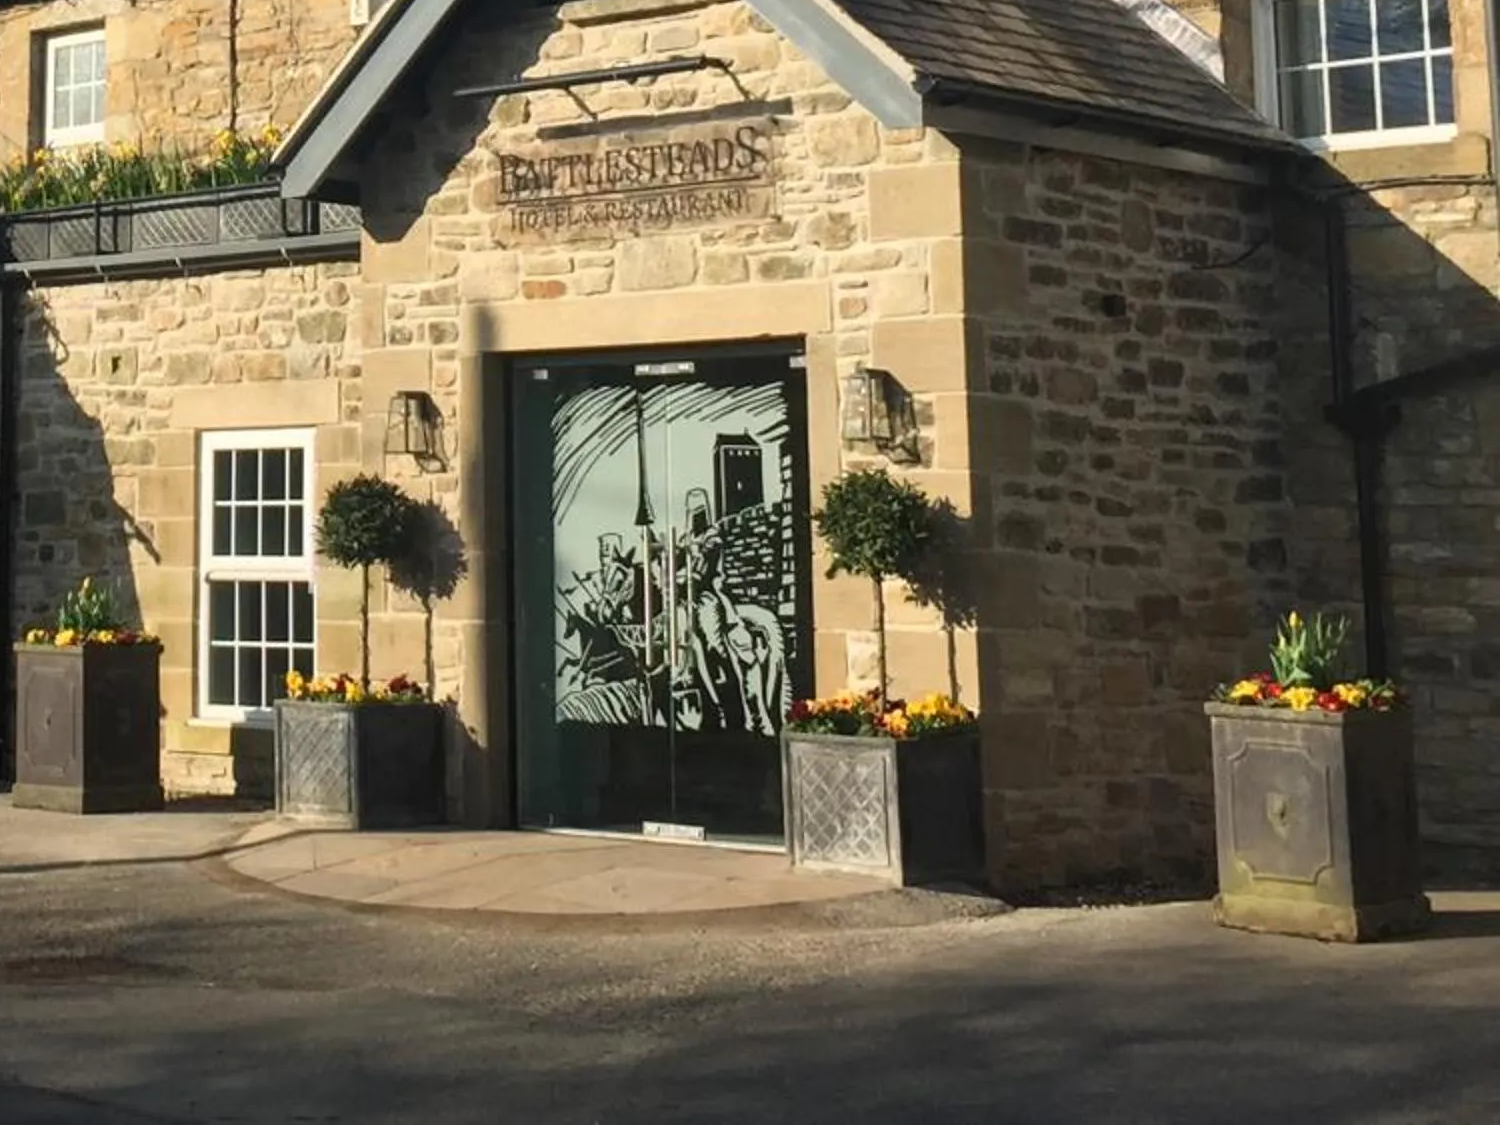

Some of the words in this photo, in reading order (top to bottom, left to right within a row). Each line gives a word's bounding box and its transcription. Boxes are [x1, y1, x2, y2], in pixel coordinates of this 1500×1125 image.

[500, 125, 766, 194] BATTLESTEADS
[509, 205, 581, 233] HOTEL
[605, 189, 743, 222] RESTAURANT
